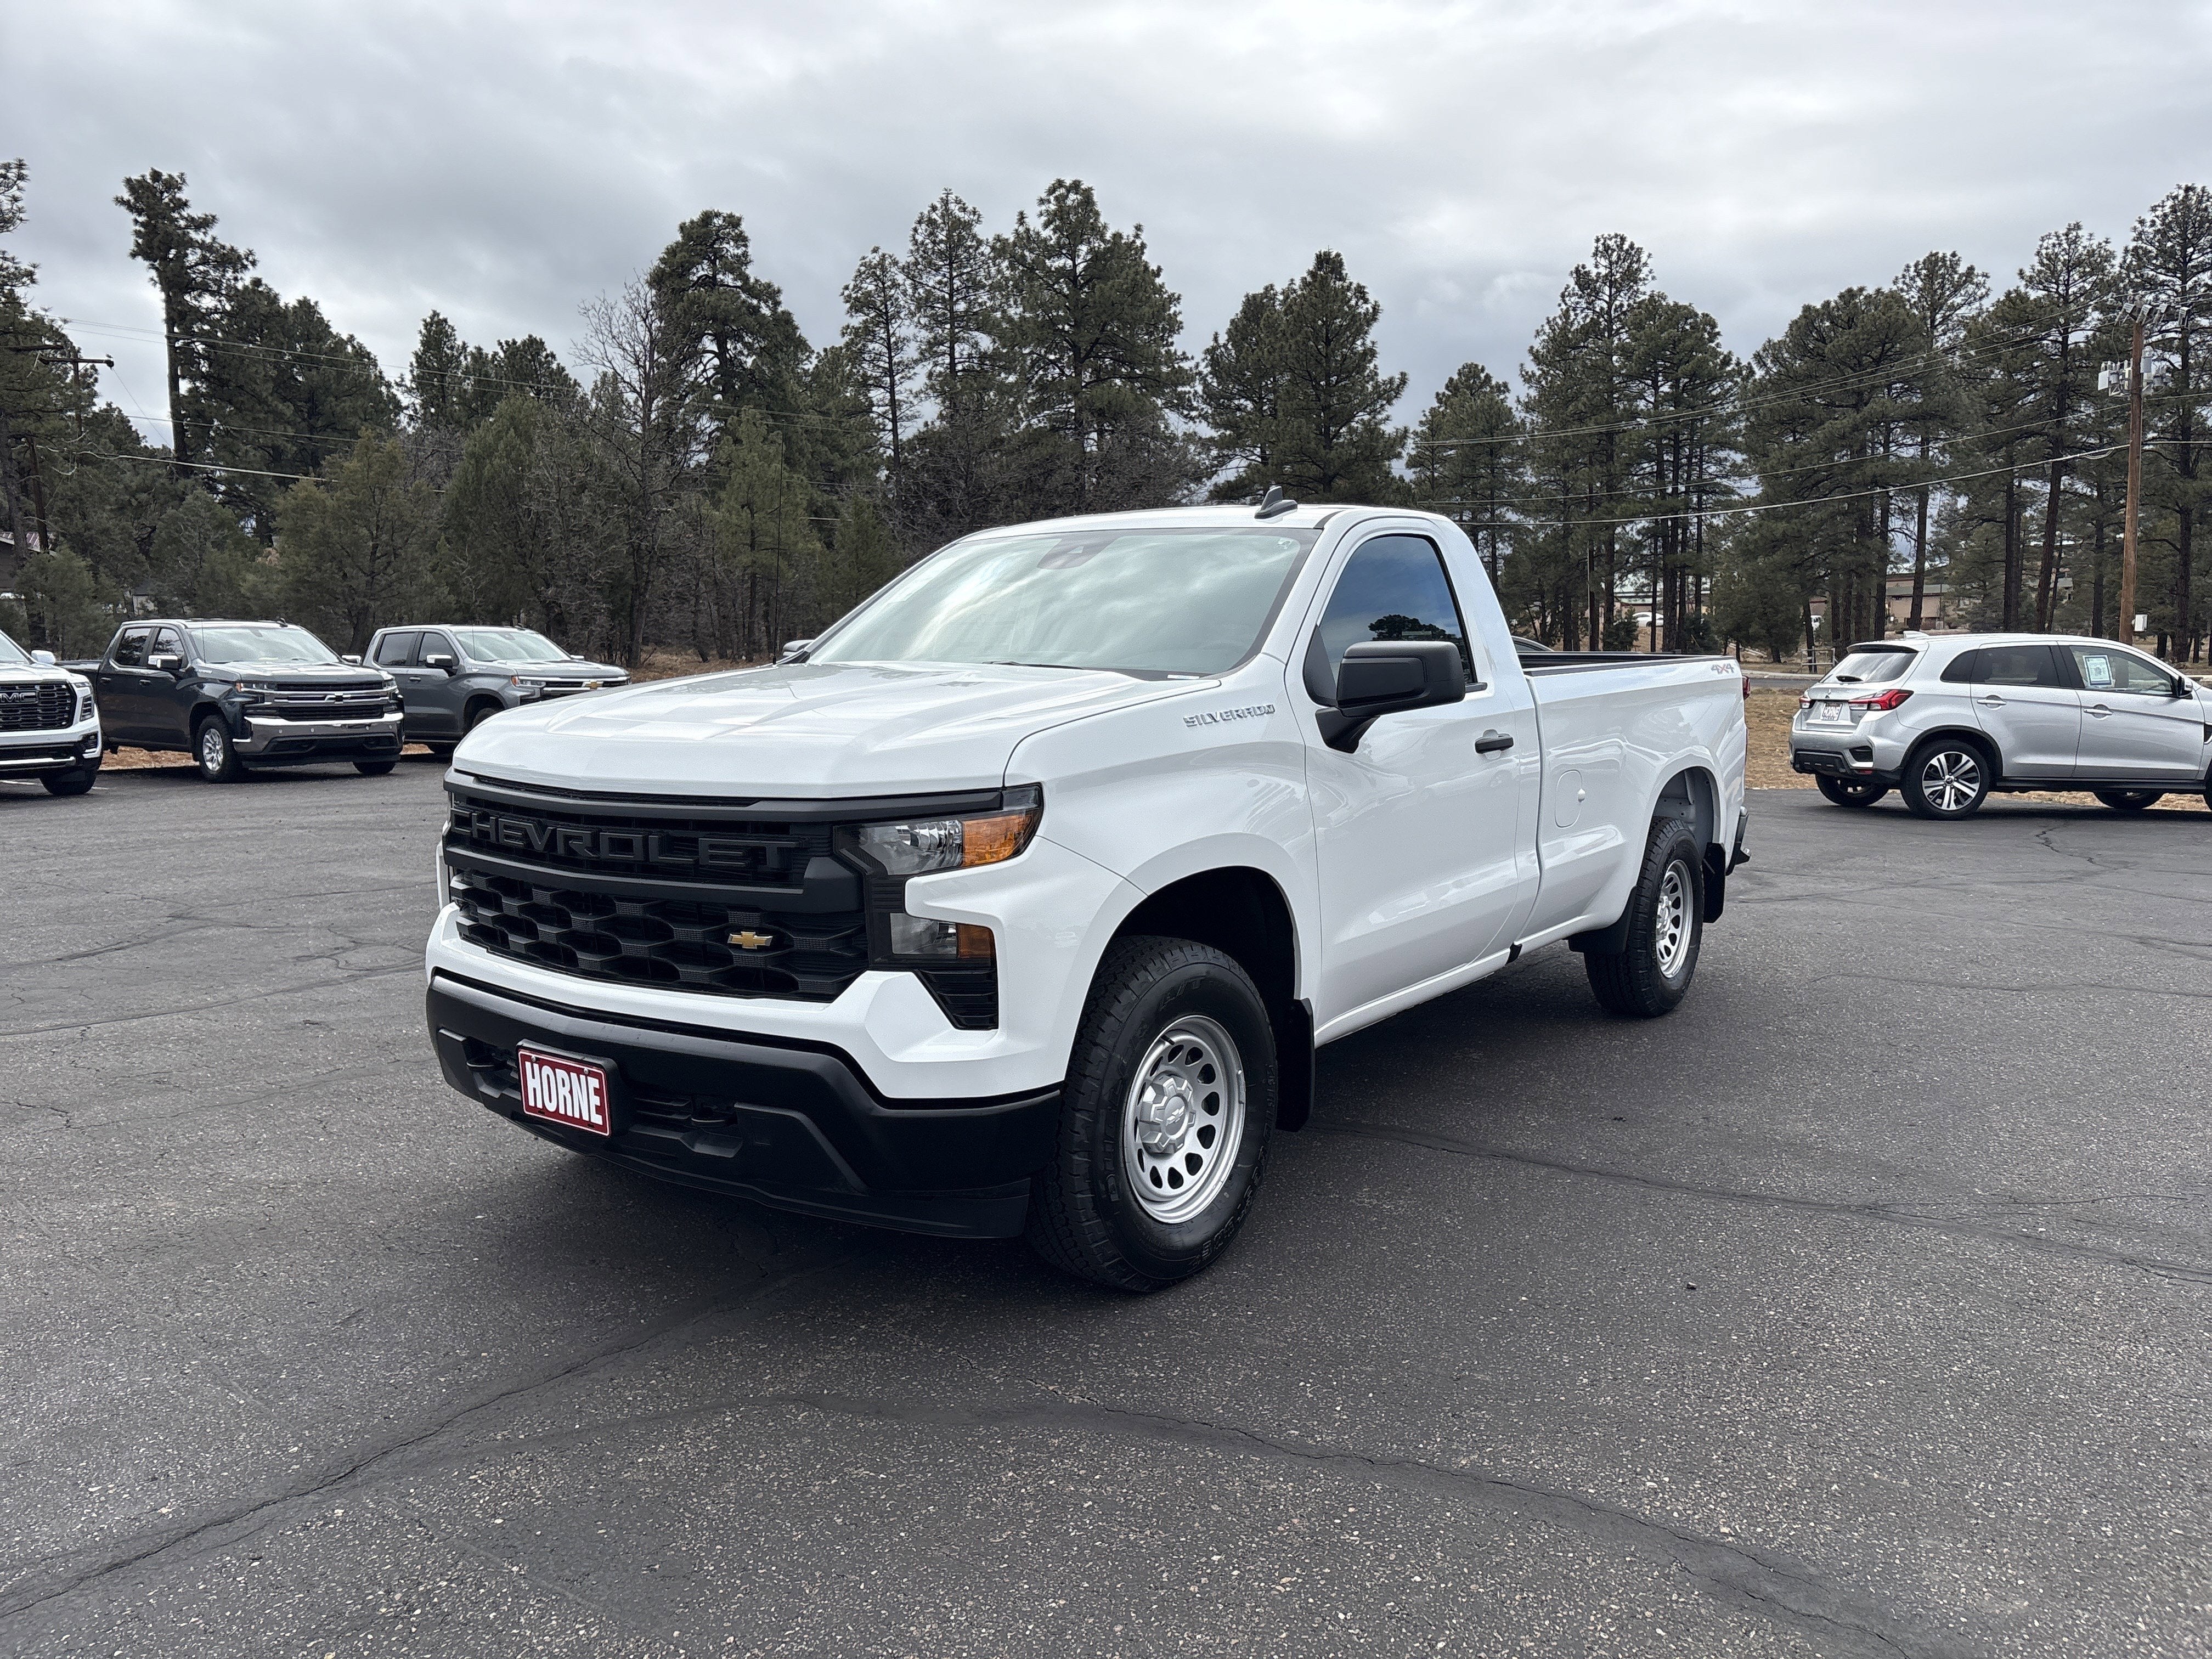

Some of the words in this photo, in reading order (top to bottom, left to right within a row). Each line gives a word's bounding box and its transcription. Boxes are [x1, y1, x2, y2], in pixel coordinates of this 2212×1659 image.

[1711, 663, 1735, 674] 4X4
[0, 692, 36, 702] MC
[1183, 704, 1276, 727] SILVERADO
[450, 808, 801, 868] CHEVROLET
[525, 1061, 603, 1125] HORNE
